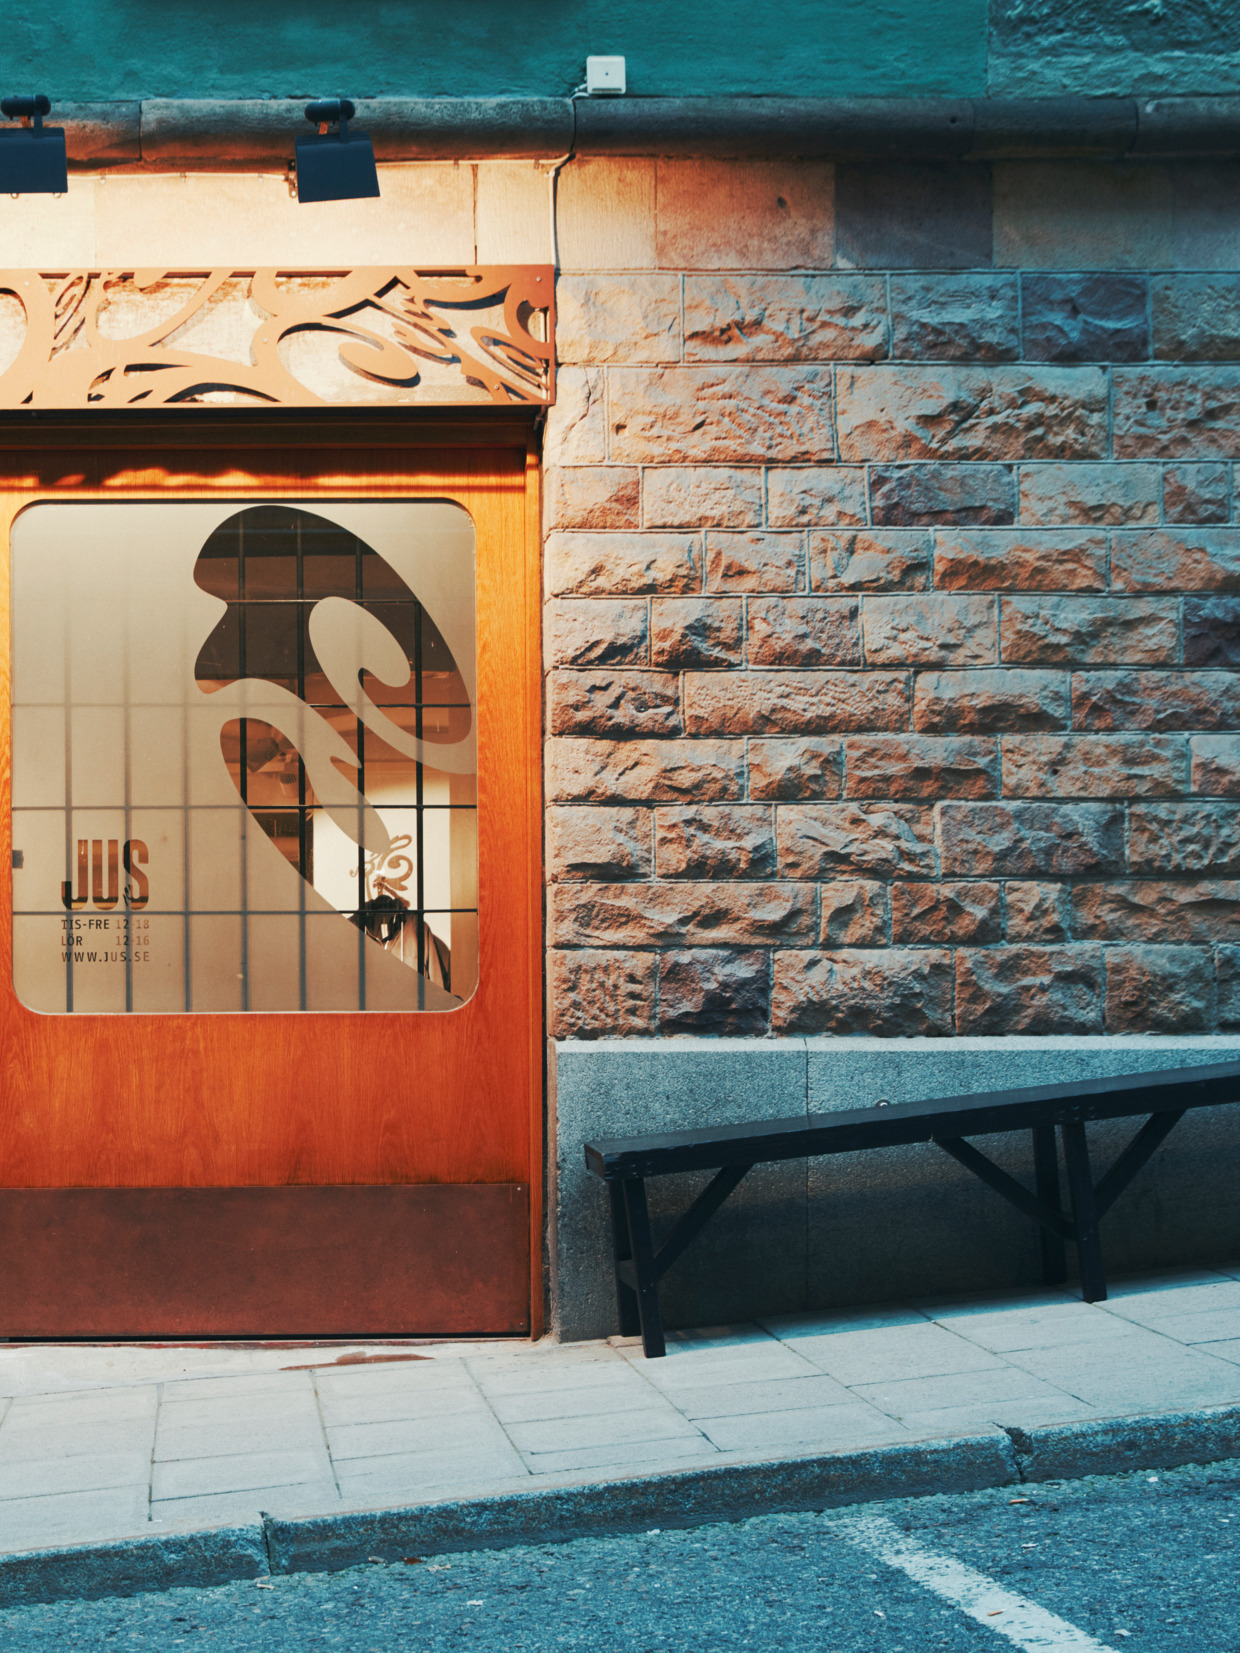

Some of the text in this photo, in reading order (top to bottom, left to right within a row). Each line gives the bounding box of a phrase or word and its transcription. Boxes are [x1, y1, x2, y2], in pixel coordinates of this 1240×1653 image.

[61, 839, 148, 910] JUS
[61, 919, 150, 930] TIS-FRE 12-18
[61, 933, 150, 946] LÖR 12-16
[61, 951, 150, 962] WWW.JUS.SE
